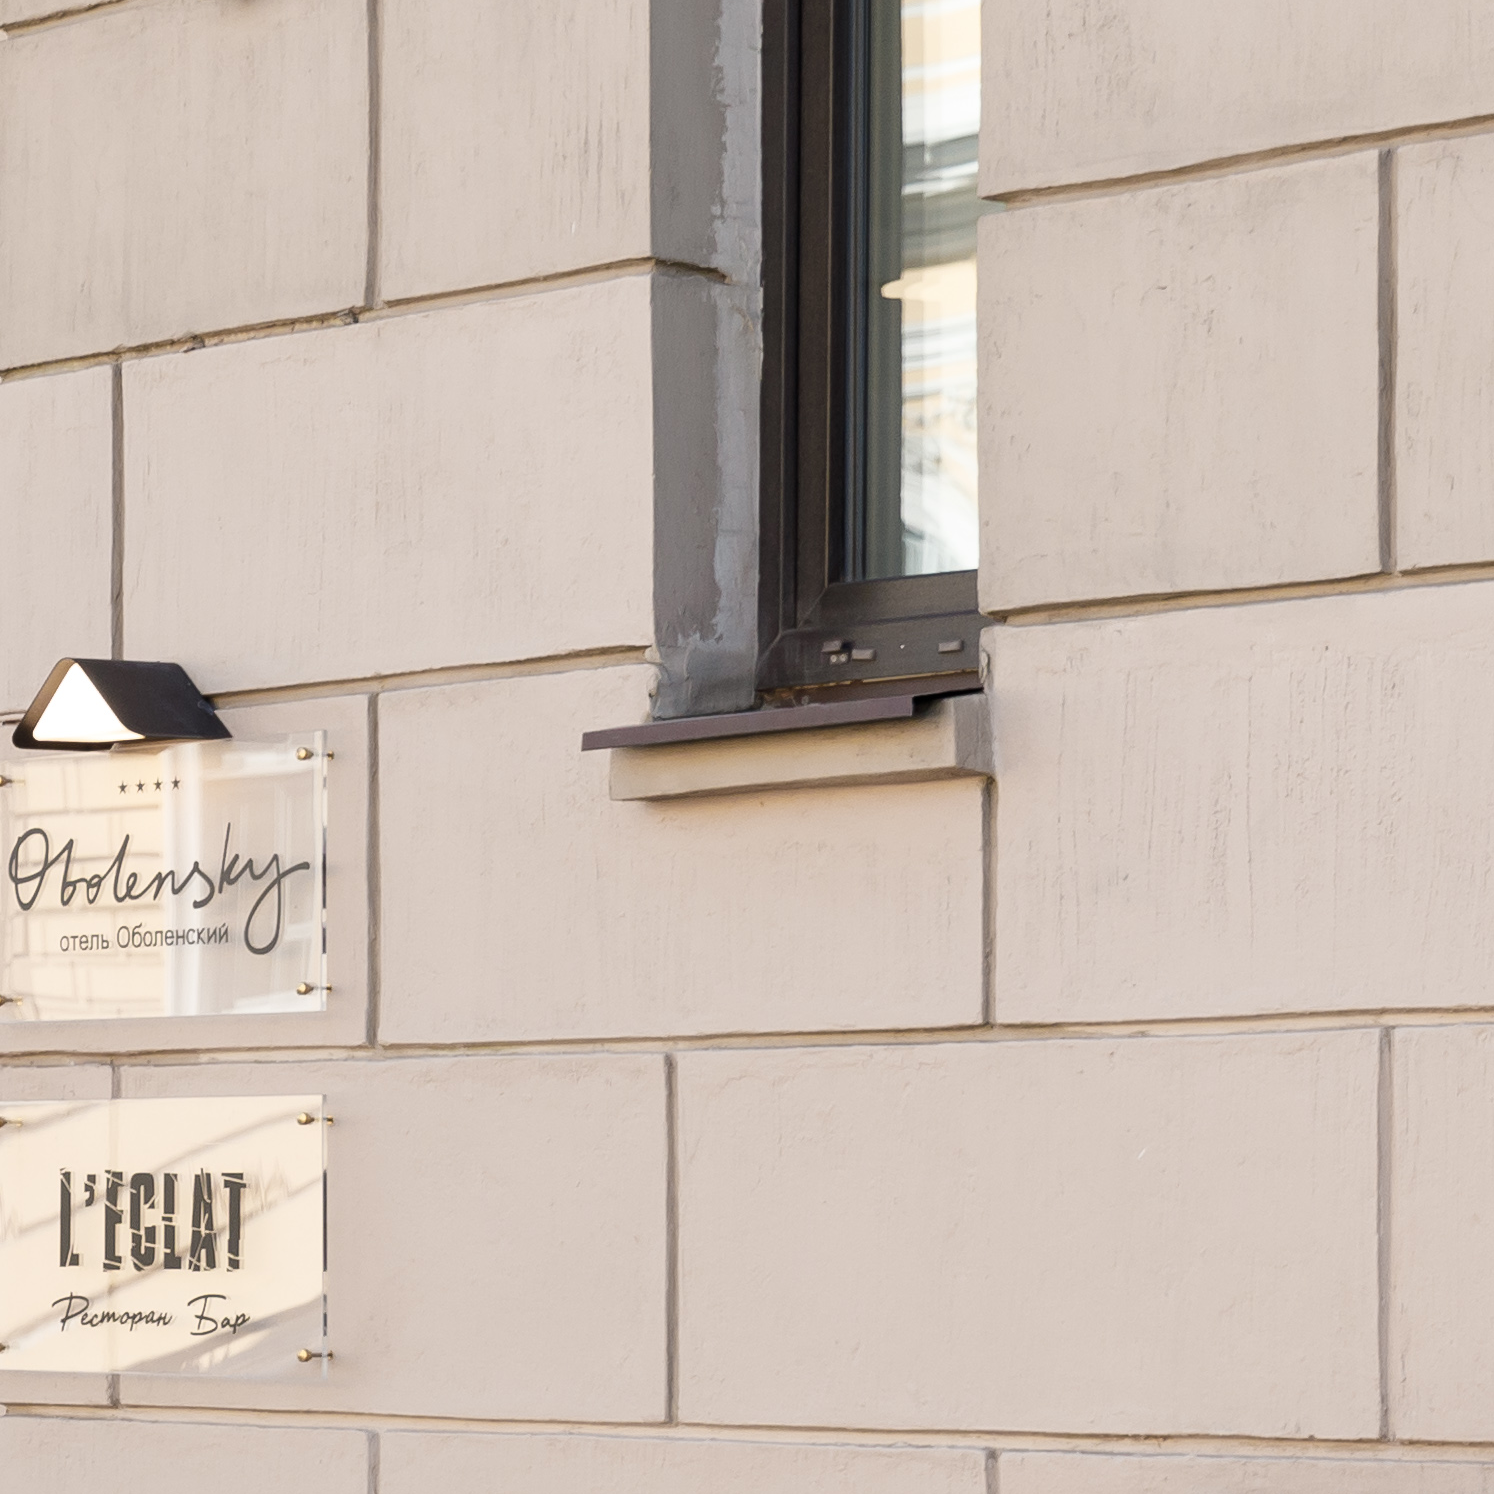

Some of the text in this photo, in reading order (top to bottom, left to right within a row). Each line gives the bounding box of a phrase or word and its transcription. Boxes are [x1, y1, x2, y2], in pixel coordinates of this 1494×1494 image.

[8, 821, 311, 956] Obolensky
[59, 922, 230, 953] отель Оболенский
[51, 1291, 251, 1337] Ресторан Бар
